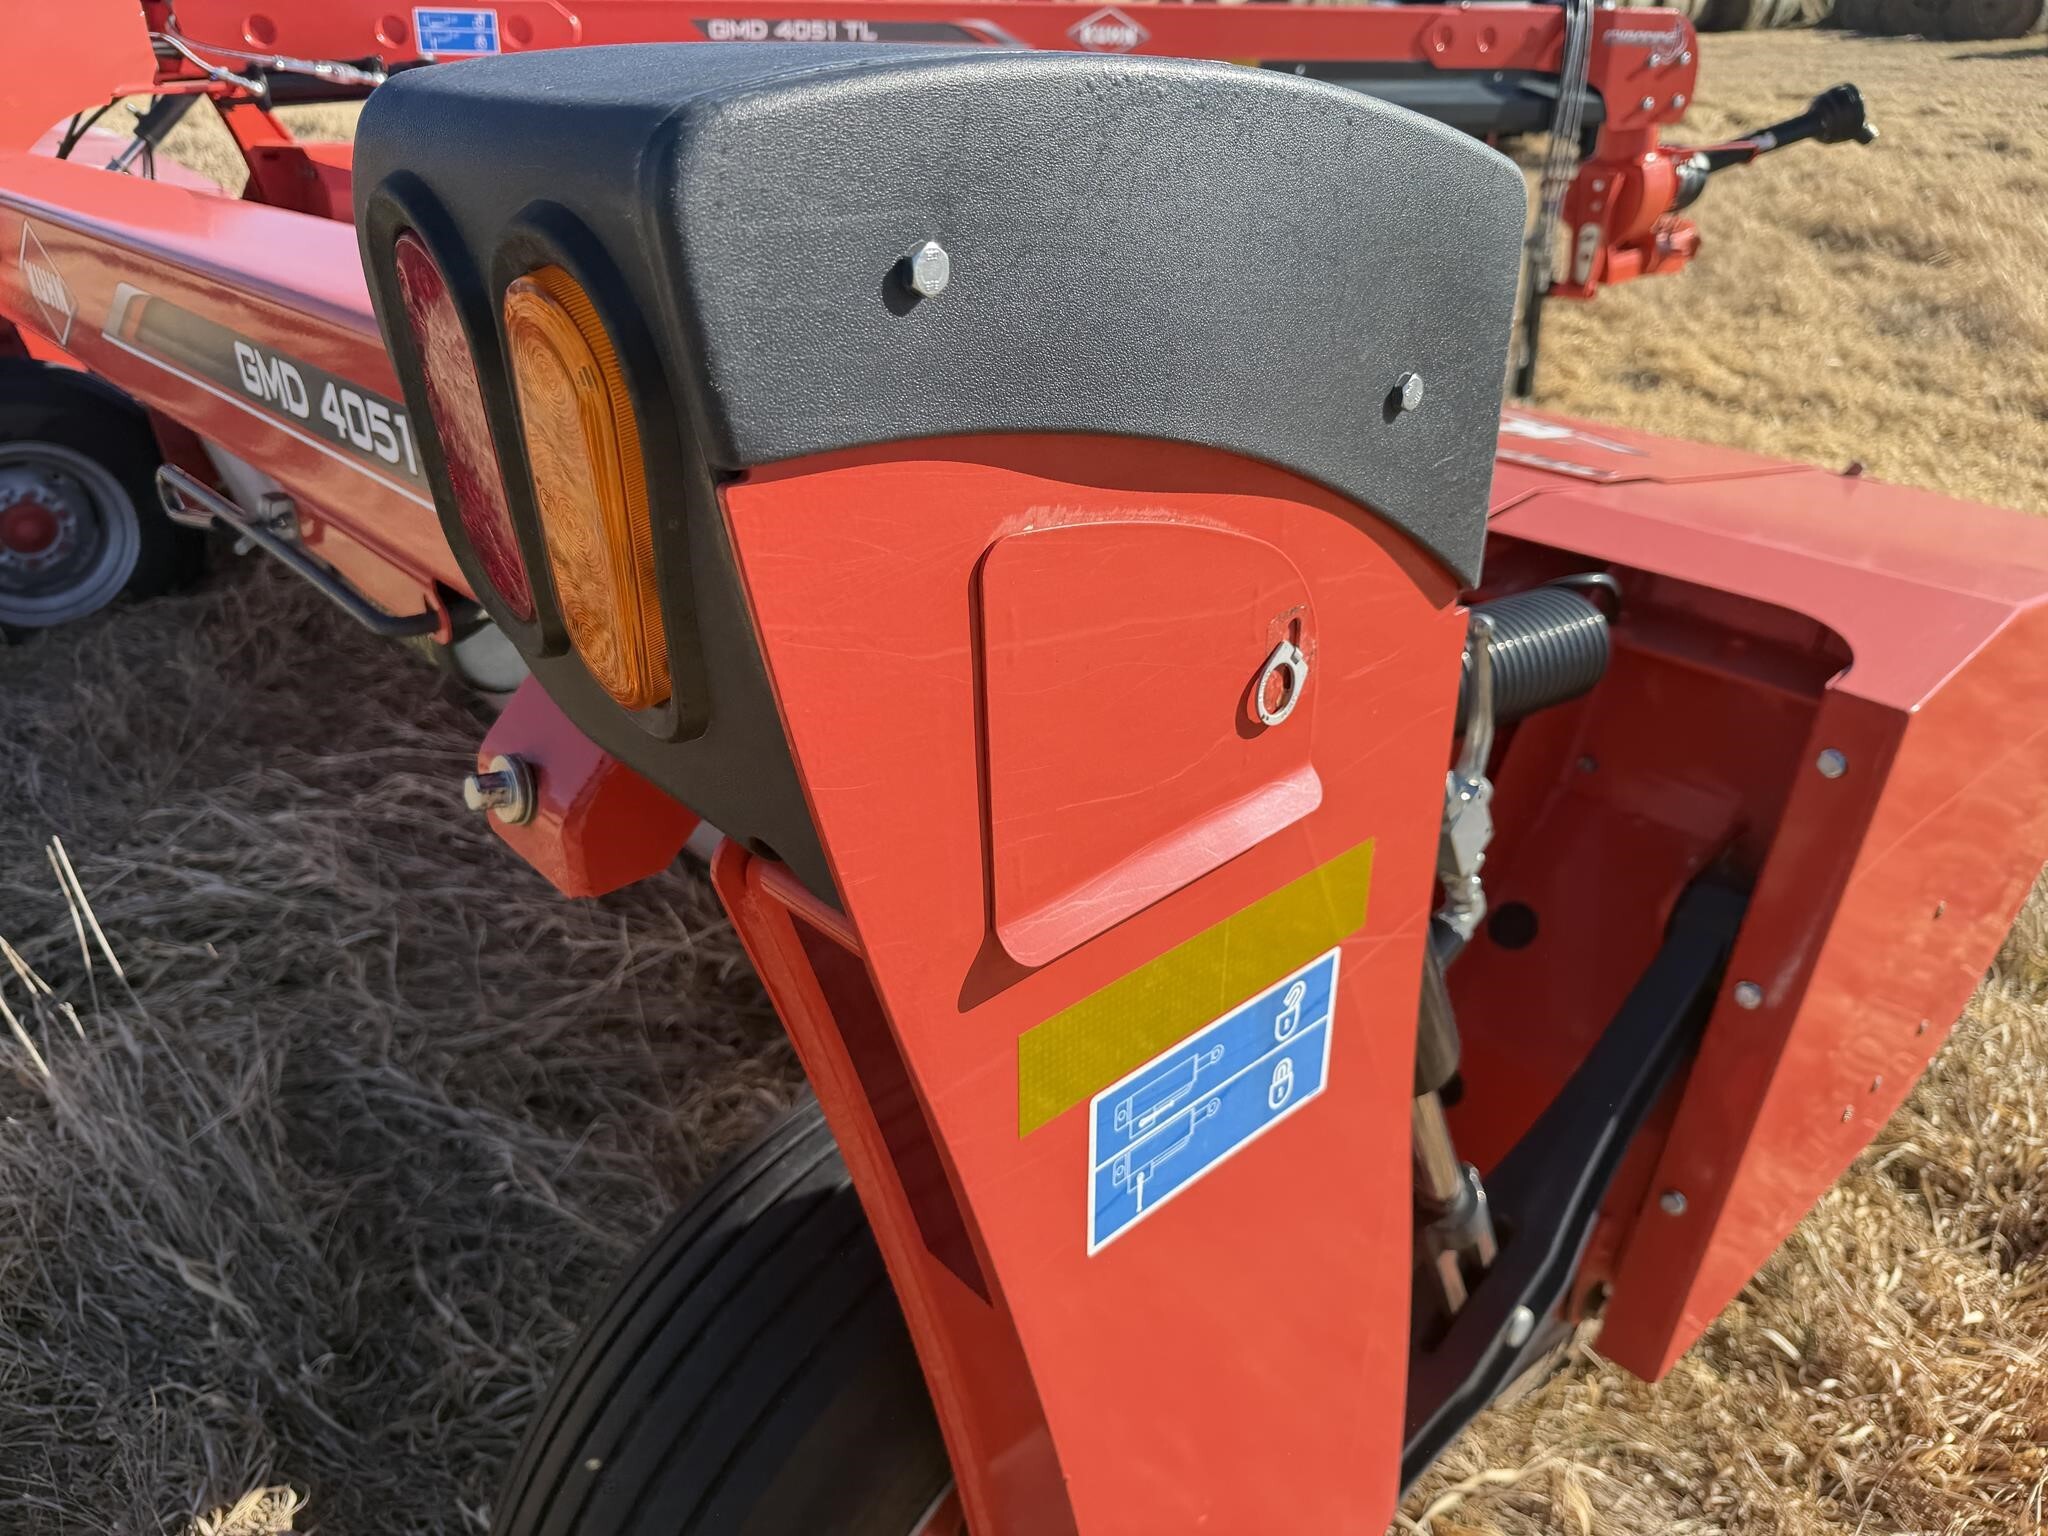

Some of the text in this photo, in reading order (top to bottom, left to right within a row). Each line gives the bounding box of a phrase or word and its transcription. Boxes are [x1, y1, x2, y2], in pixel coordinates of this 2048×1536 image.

[708, 19, 878, 42] GMD 4051 TL
[234, 341, 418, 476] GMD 4051
